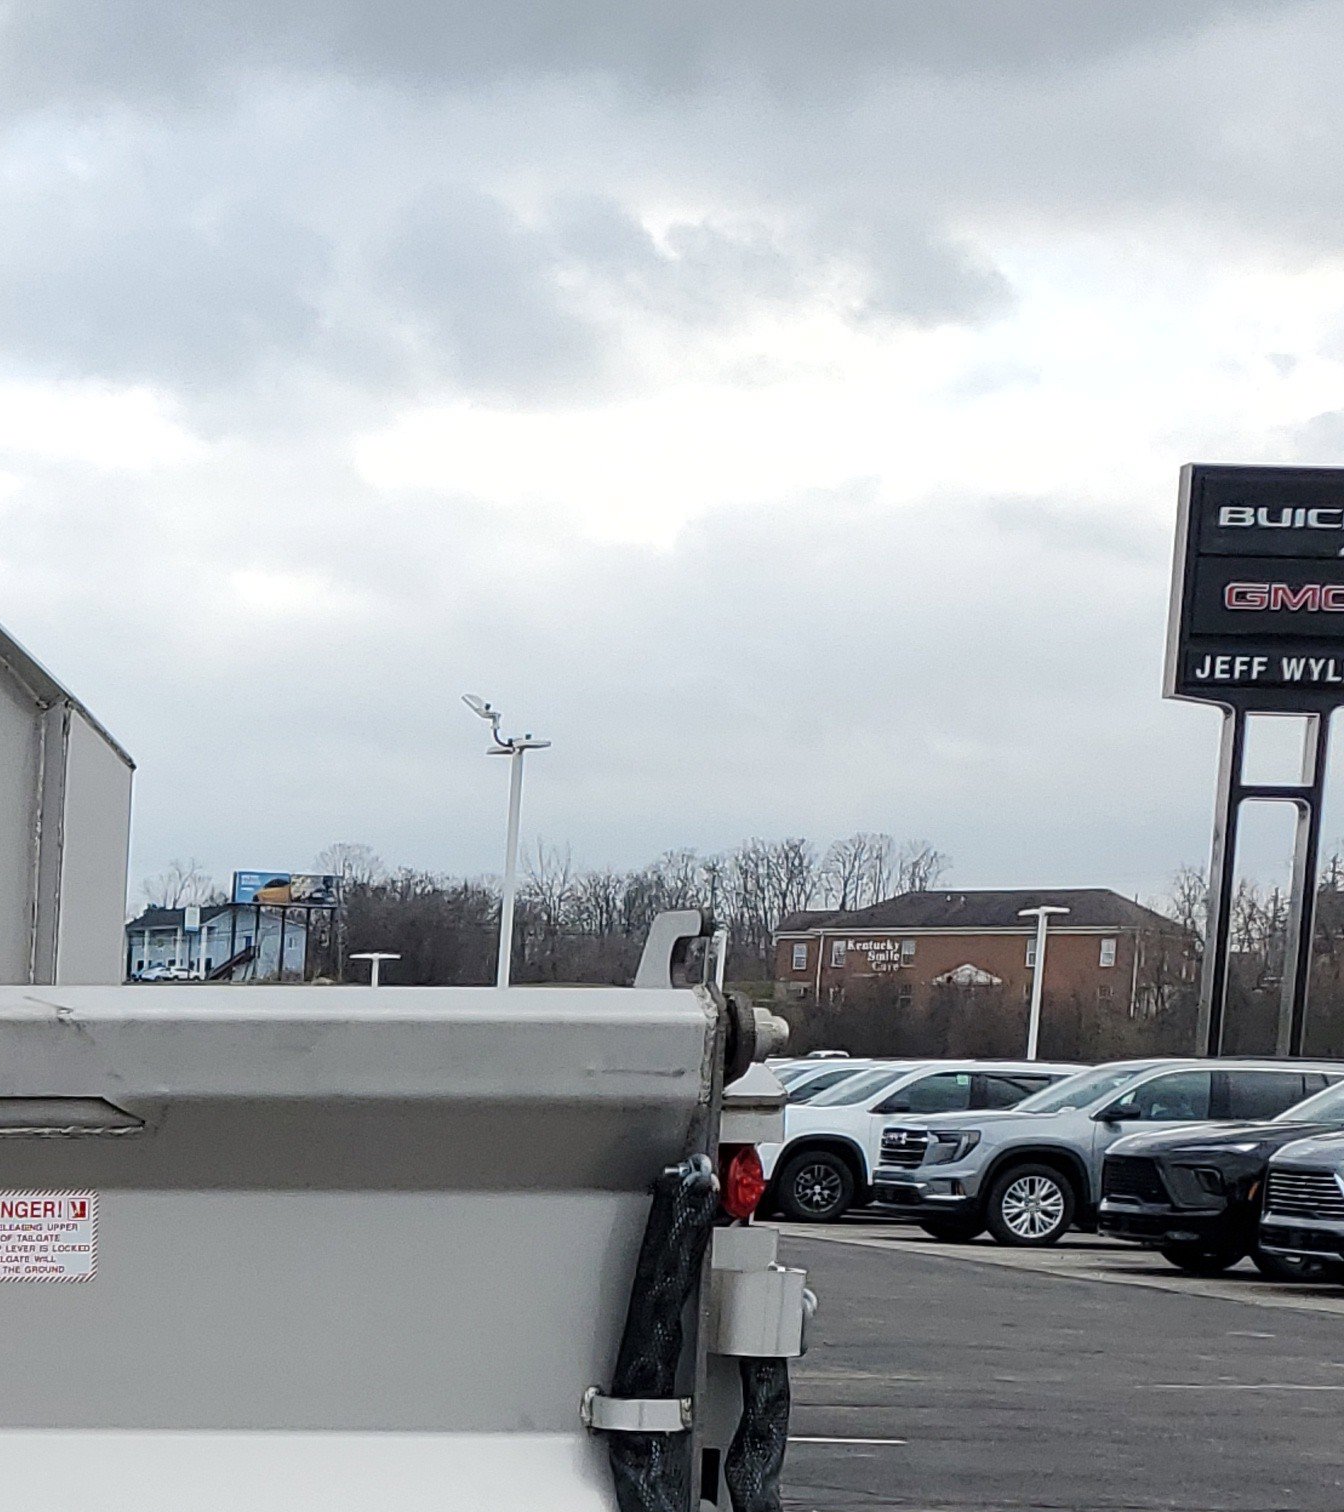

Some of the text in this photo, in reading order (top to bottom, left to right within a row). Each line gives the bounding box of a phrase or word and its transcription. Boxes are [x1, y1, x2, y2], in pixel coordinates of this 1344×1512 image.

[1218, 506, 1344, 529] BUIC
[1195, 655, 1344, 682] JEFF WYL
[847, 939, 900, 951] Kentucky
[867, 951, 900, 961] Smile
[872, 961, 900, 972] Care
[47, 1223, 78, 1232] UPPER
[0, 1233, 13, 1243] OF
[17, 1233, 61, 1243] TAILGATE
[5, 1244, 36, 1253] LEVER
[39, 1244, 49, 1253] IS
[52, 1244, 91, 1253] LOCKED
[34, 1255, 56, 1263] WILL
[2, 1265, 21, 1274] THE
[24, 1265, 65, 1274] GROUND
